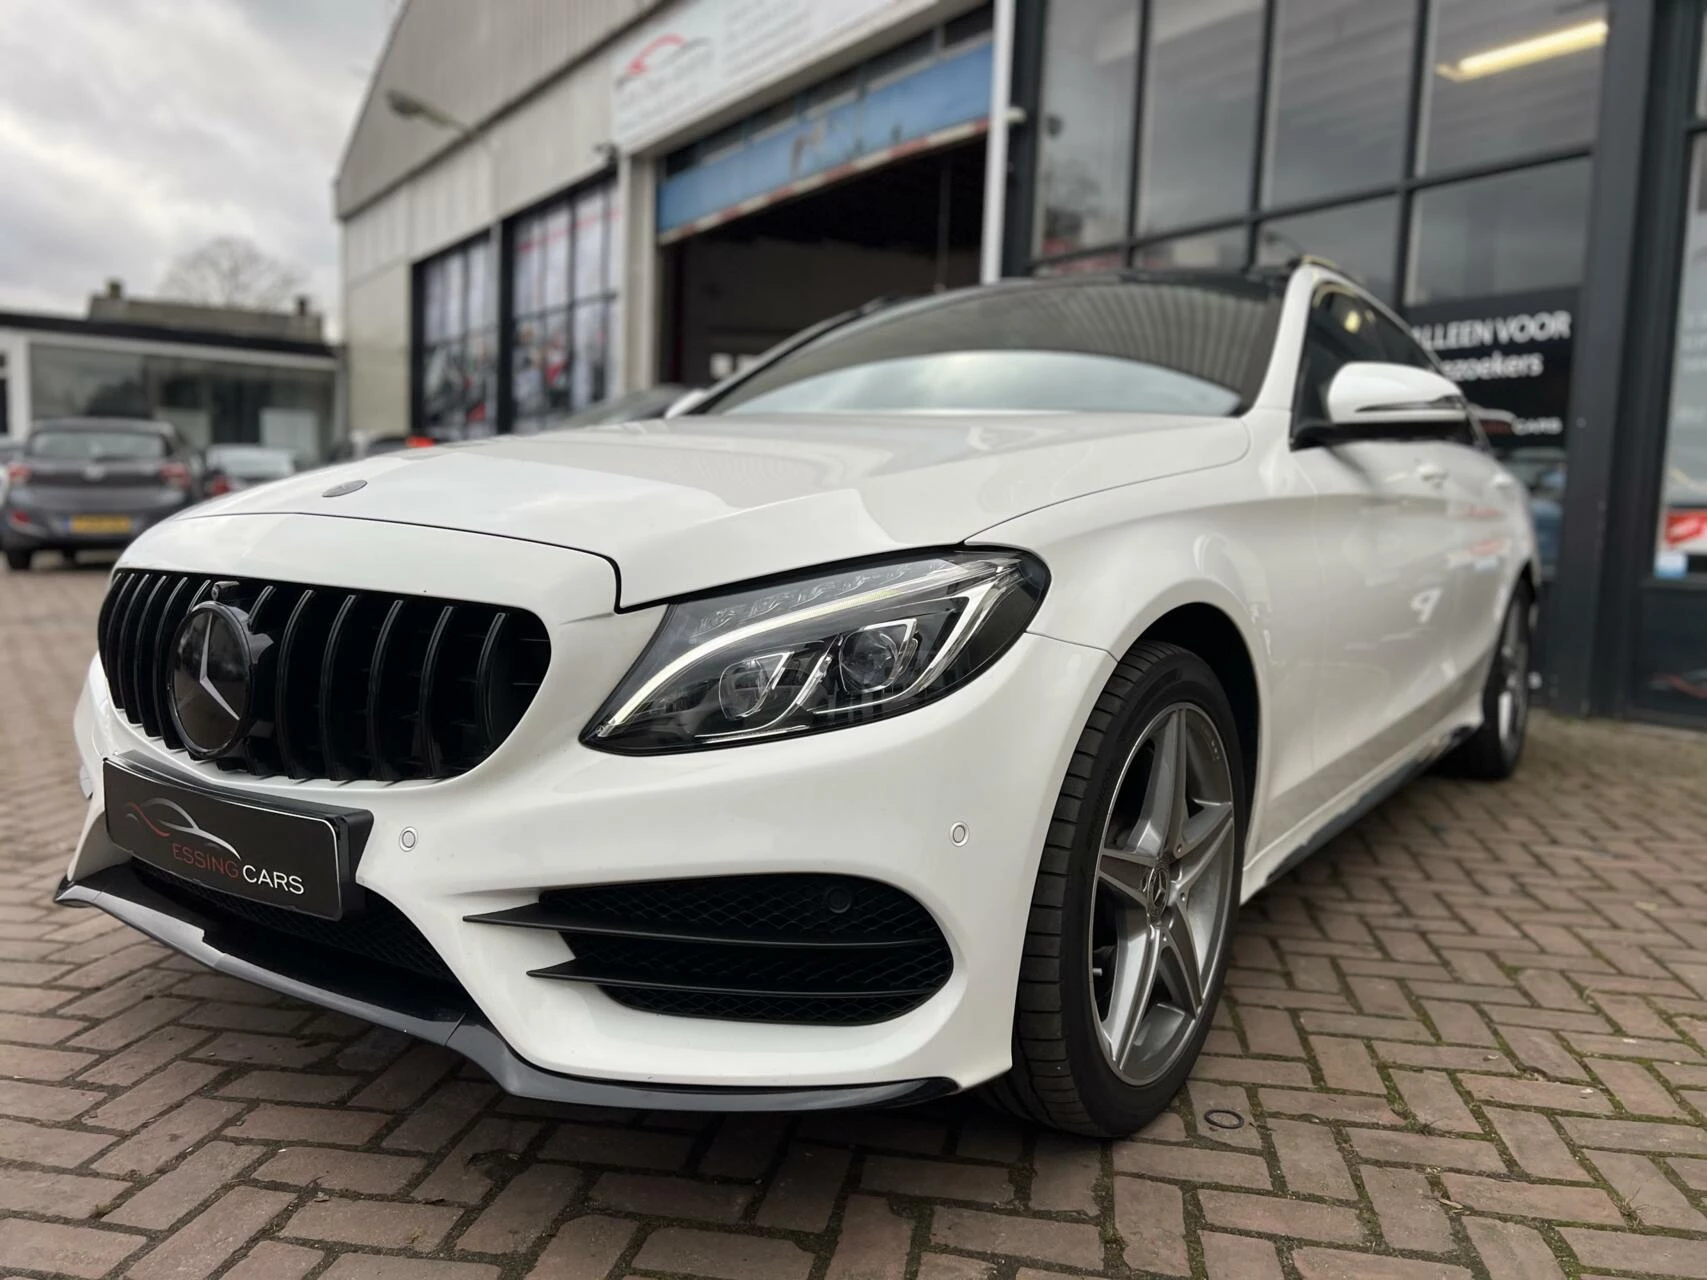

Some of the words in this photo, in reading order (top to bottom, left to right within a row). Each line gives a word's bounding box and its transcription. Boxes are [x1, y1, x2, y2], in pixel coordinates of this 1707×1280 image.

[1495, 311, 1571, 344] VOOR
[172, 843, 239, 878] ESSING
[242, 865, 305, 895] CARS
